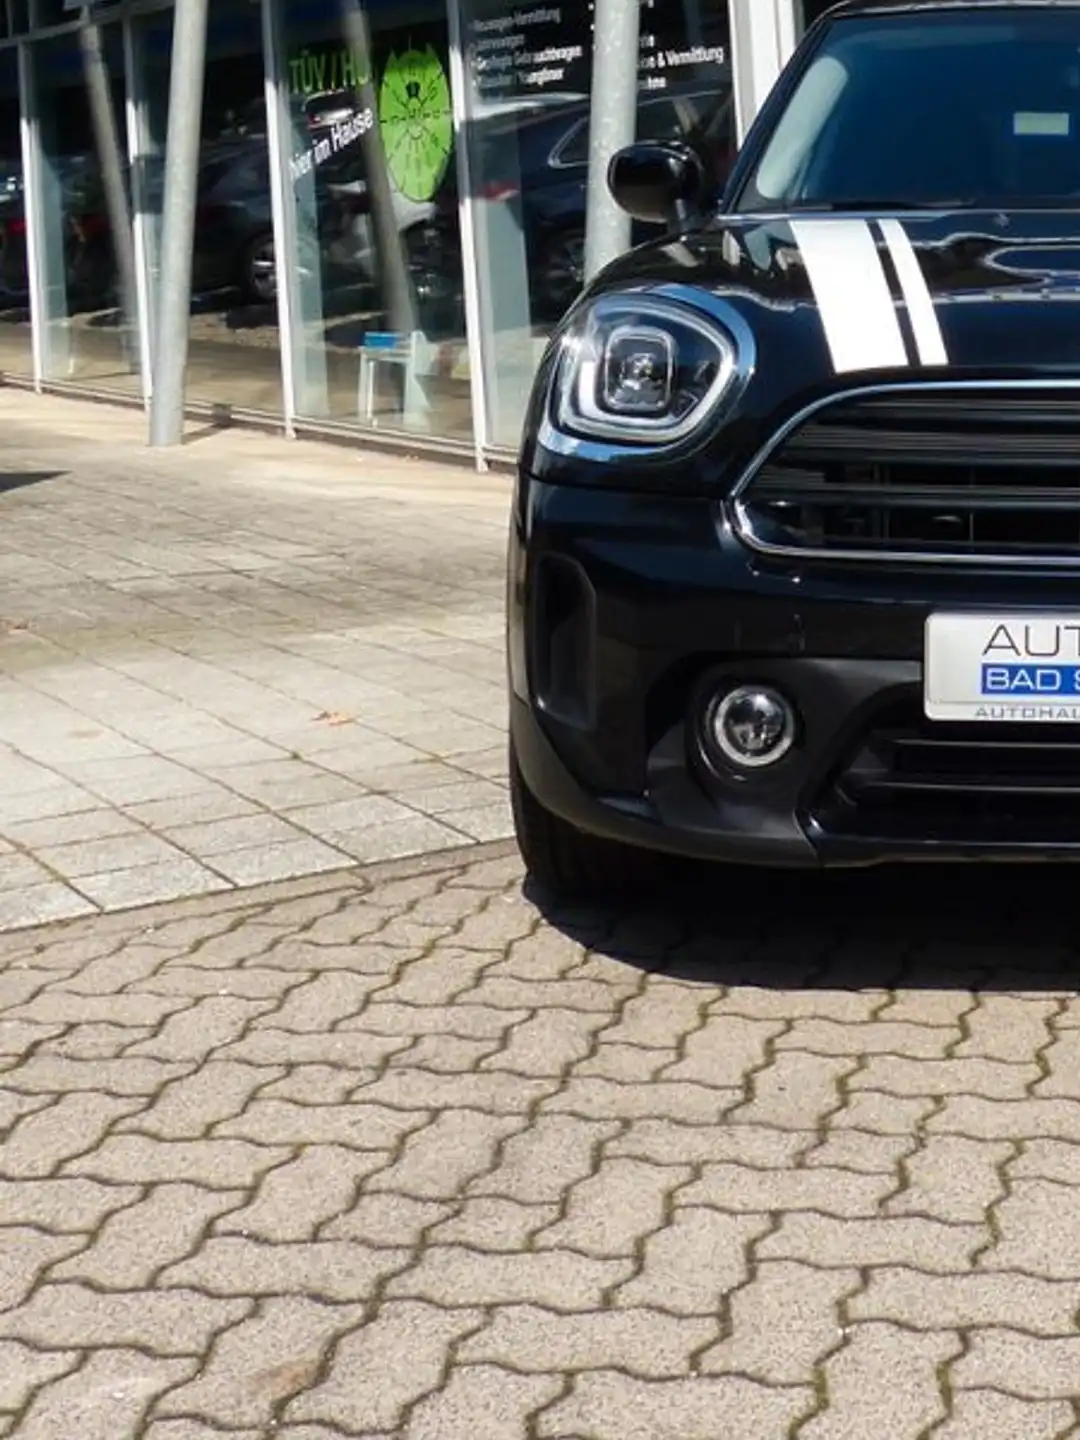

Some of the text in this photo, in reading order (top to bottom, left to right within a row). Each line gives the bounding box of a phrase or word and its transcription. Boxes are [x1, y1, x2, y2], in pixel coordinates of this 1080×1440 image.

[312, 138, 332, 165] im
[329, 107, 374, 153] Hause
[985, 670, 1061, 691] BAD
